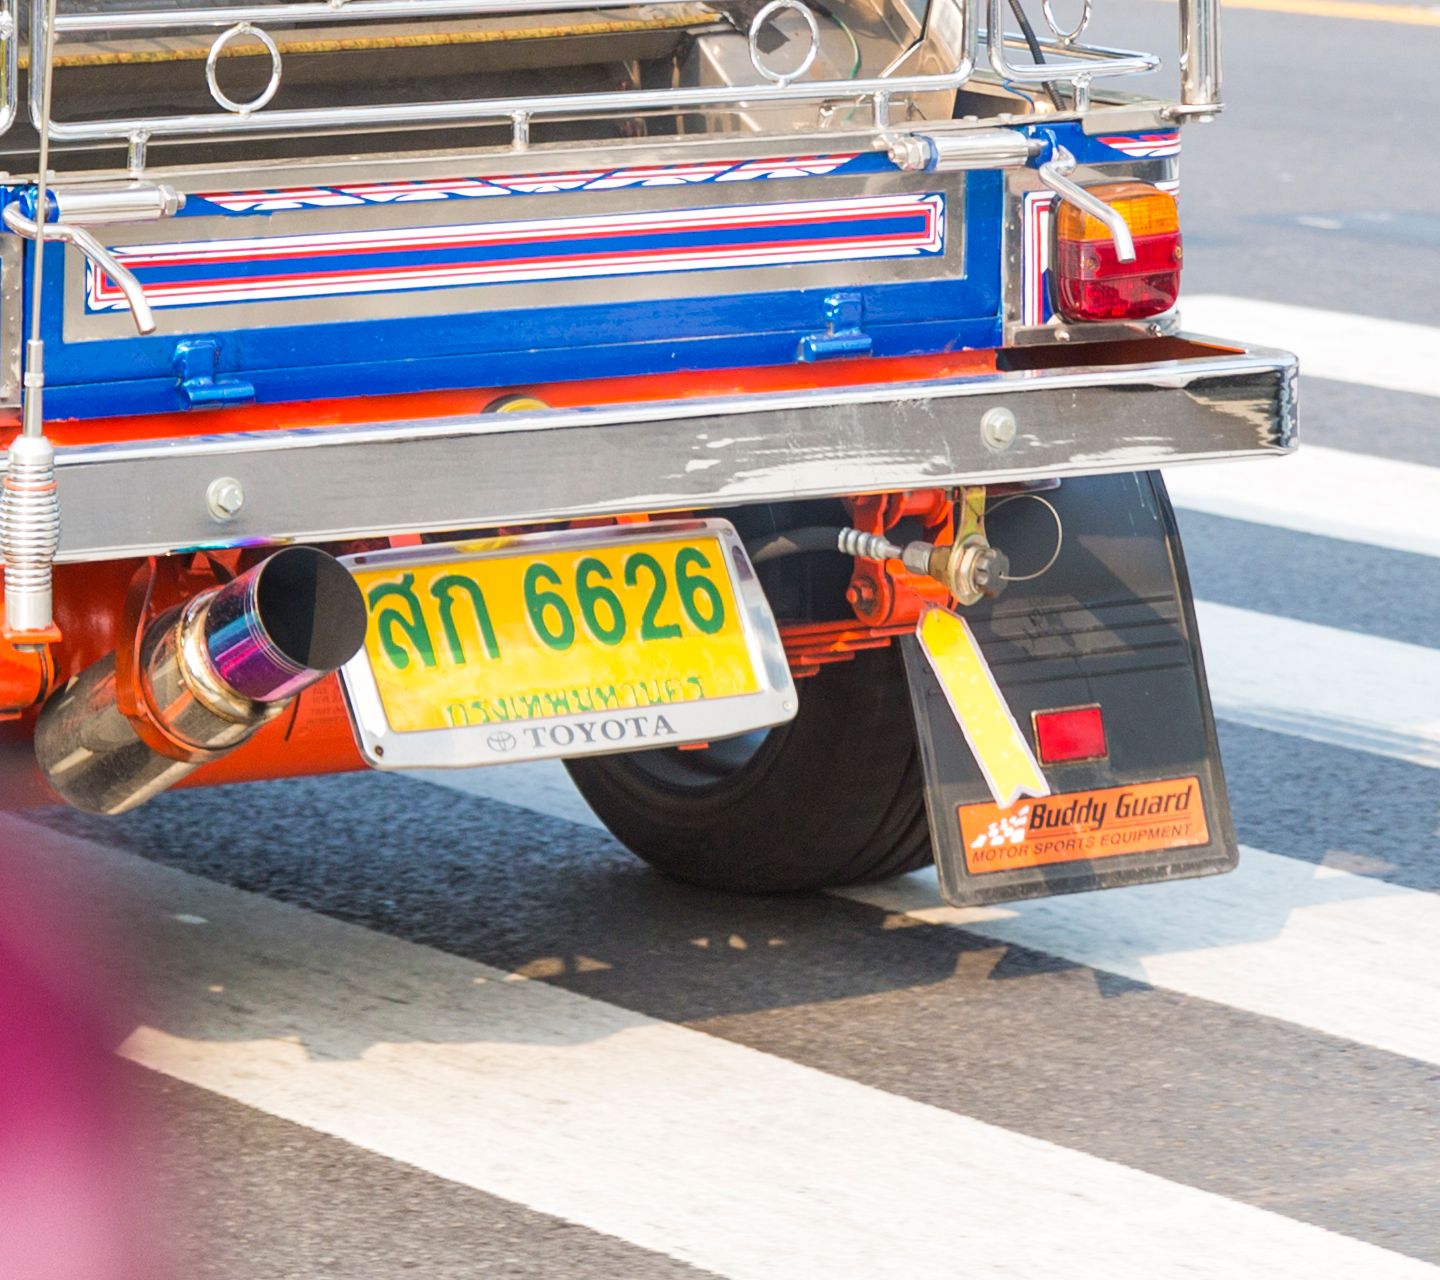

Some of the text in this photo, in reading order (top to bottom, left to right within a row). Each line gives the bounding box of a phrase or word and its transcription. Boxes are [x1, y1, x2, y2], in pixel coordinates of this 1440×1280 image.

[368, 547, 725, 669] สก 6626
[447, 676, 706, 727] กรงเทพมหานคร
[524, 715, 678, 750] TOYOTA
[1029, 784, 1193, 831] Buddy Guard
[972, 823, 1194, 863] MOTOR SPORTS EQUIPMENT
